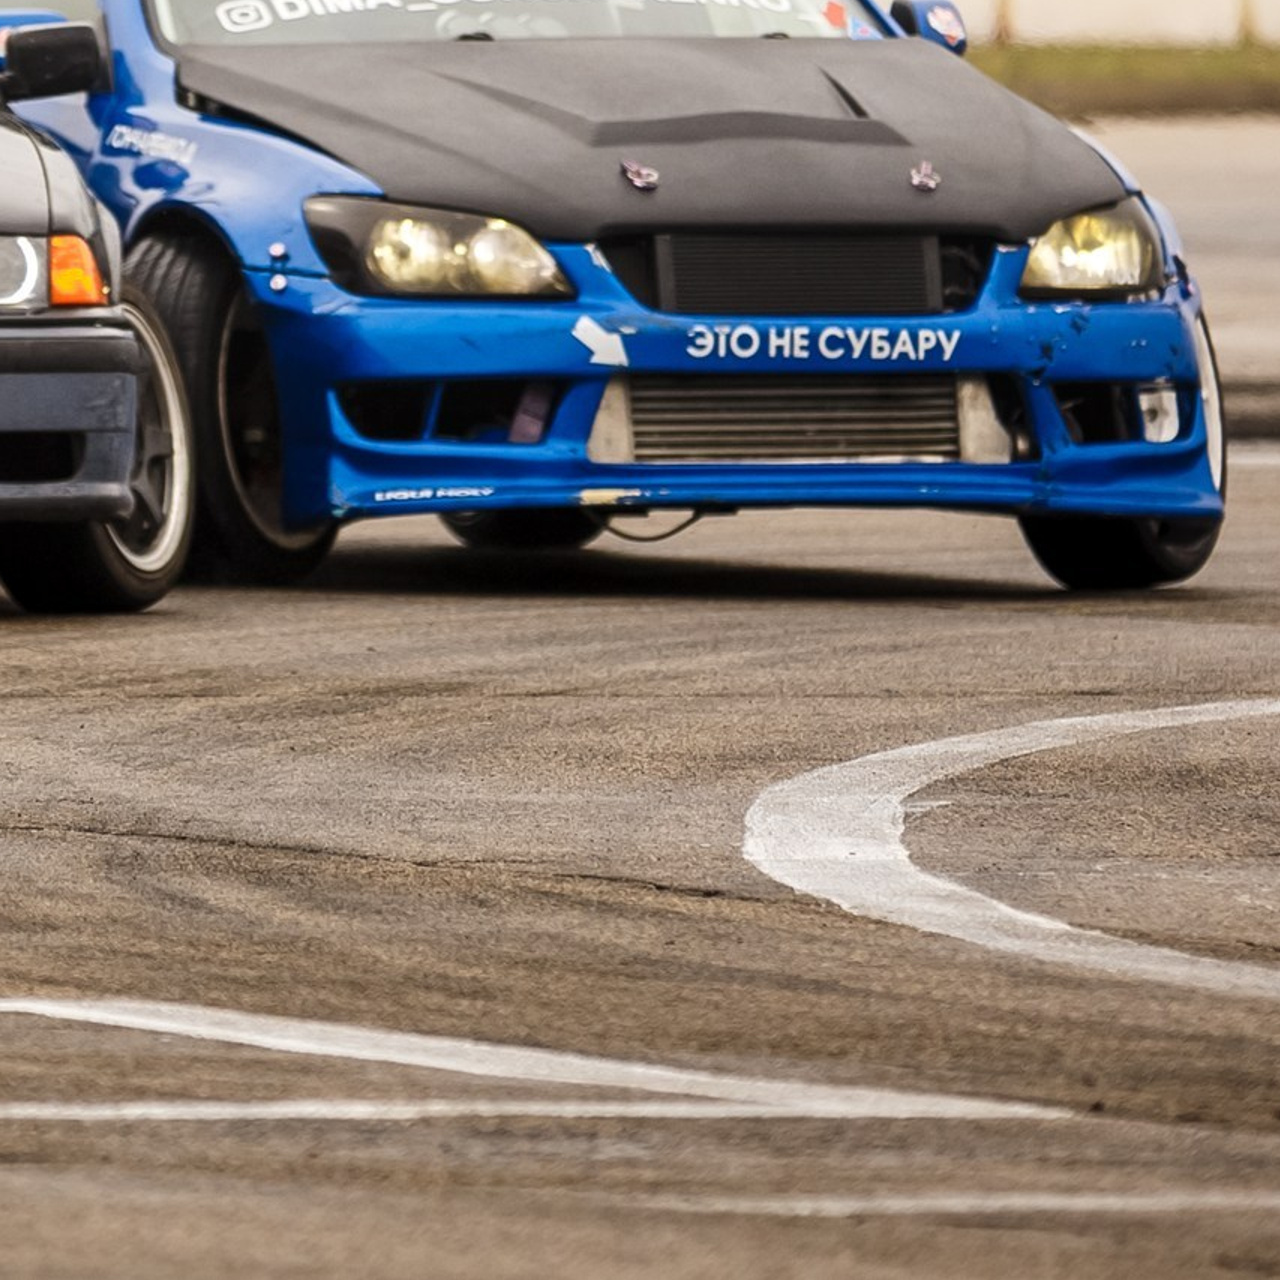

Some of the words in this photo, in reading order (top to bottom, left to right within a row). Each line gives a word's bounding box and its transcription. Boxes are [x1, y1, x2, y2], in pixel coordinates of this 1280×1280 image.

[685, 324, 761, 359] ЭТО
[768, 326, 811, 359] НЕ
[819, 325, 962, 362] СУБАРУ
